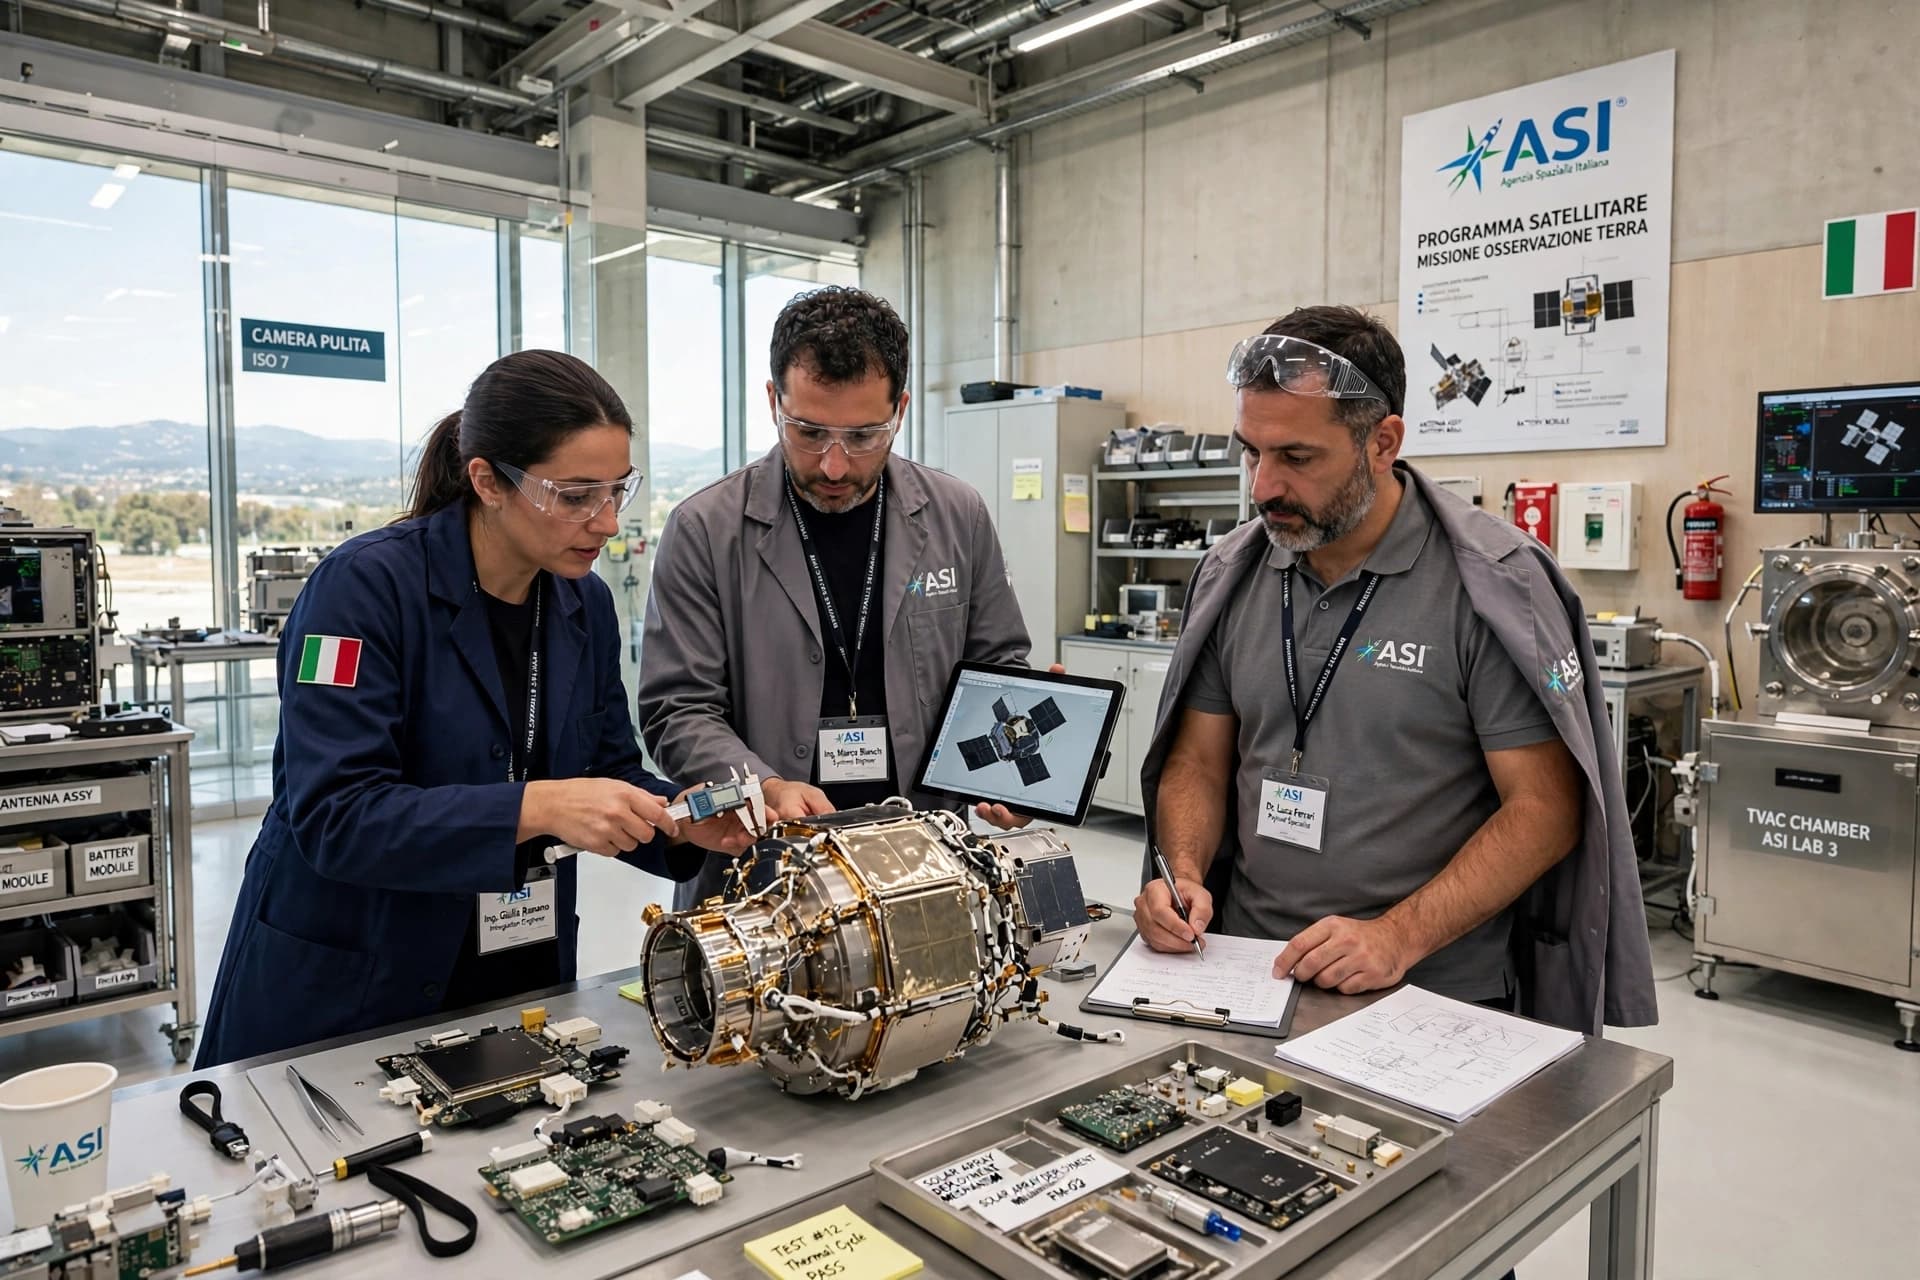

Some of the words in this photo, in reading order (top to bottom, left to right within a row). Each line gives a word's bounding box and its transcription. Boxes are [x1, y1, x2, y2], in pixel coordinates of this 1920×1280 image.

[1502, 100, 1610, 171] ASI
[1417, 218, 1524, 248] PROGRAMMA
[1529, 194, 1648, 230] SATELLITARE
[1417, 247, 1480, 269] MISSIONE
[1483, 229, 1592, 258] OSSERVAZIONE
[1599, 219, 1648, 240] TERRA
[252, 328, 317, 348] CAMERA
[320, 334, 371, 353] PULITA
[252, 352, 277, 368] ISO
[281, 355, 289, 369] 7
[925, 567, 956, 592] ASI
[1377, 640, 1426, 667] ASI
[1560, 647, 1581, 684] ASI
[844, 731, 865, 742] ASI
[0, 790, 59, 810] ANTENNA
[63, 789, 93, 803] ASSY
[1284, 788, 1303, 801] ASI
[1293, 808, 1316, 821] Ferrari
[1747, 807, 1786, 828] TVAC
[1789, 815, 1871, 841] CHAMBER
[89, 846, 135, 862] BATTERY
[1762, 831, 1788, 849] ASI
[1792, 836, 1824, 855] LAB
[1828, 842, 1838, 857] 3
[2, 872, 49, 889] MODULE
[90, 861, 134, 876] MODULE
[509, 887, 531, 902] ASI
[484, 914, 498, 924] Ing.
[50, 1126, 102, 1168] ASI
[771, 1236, 806, 1257] TEST
[813, 1224, 842, 1242] #12
[784, 1244, 834, 1272] Thermal
[835, 1232, 867, 1253] Cycle
[806, 1260, 846, 1280] PASS
